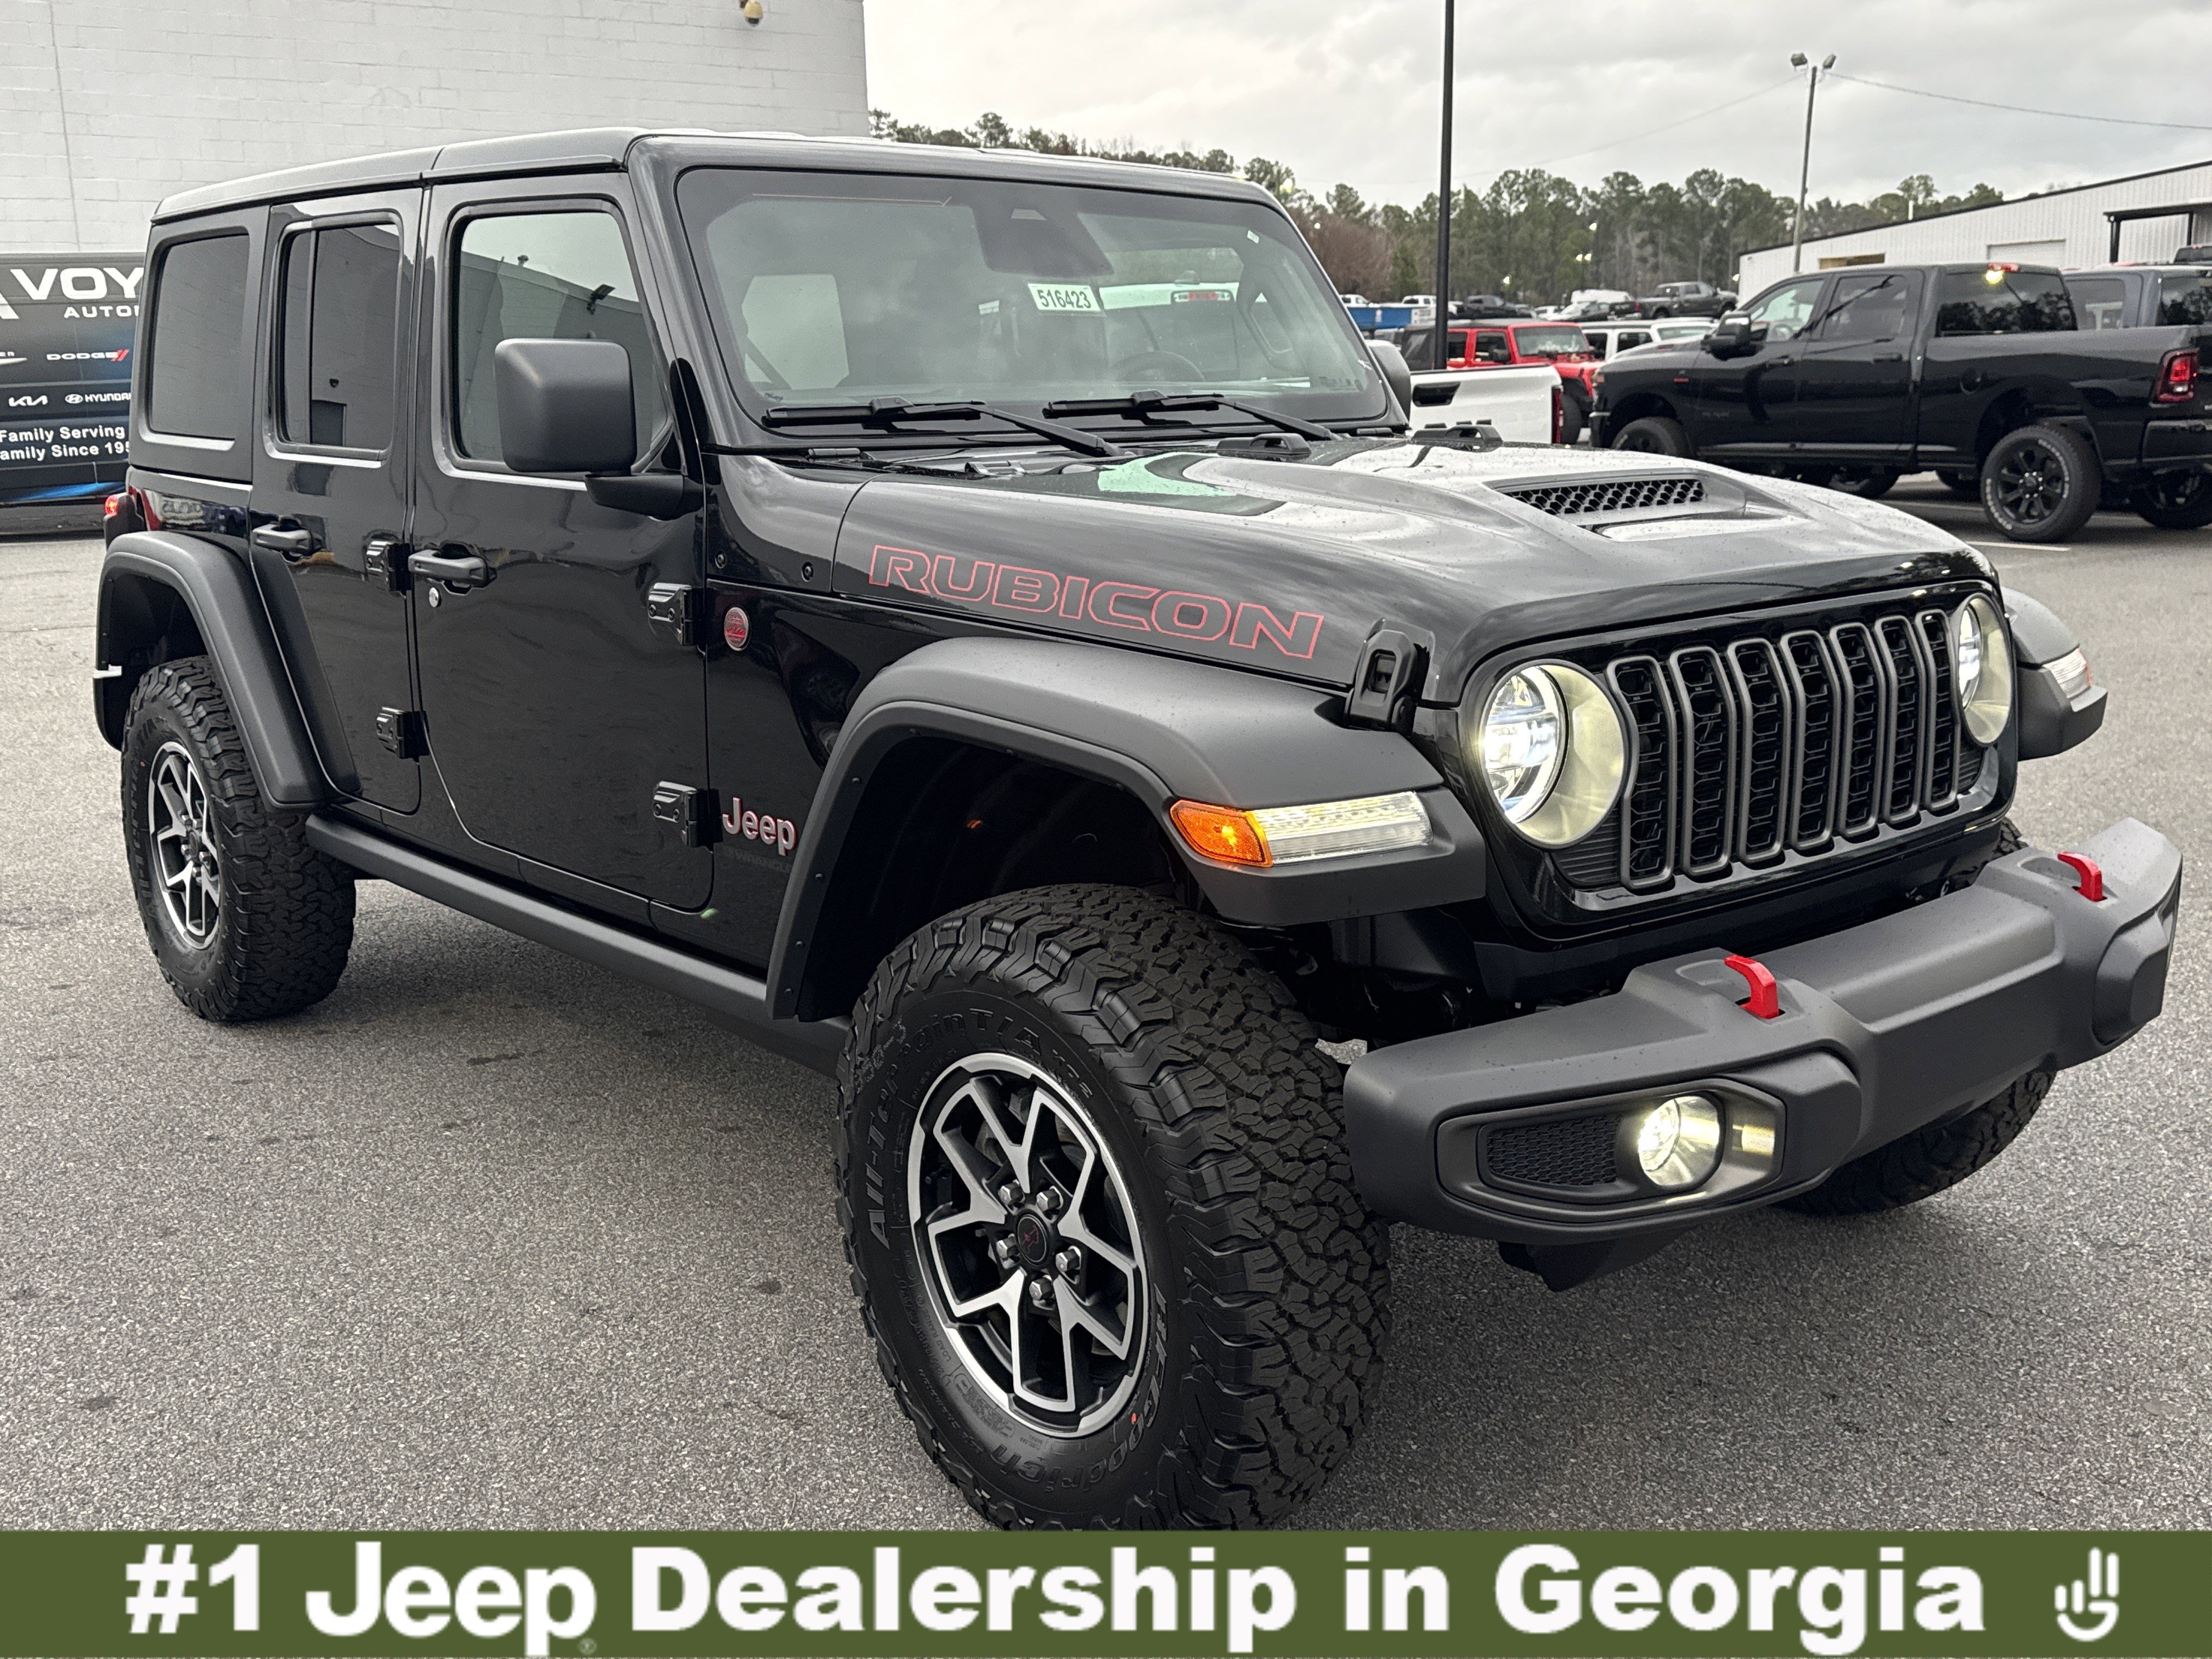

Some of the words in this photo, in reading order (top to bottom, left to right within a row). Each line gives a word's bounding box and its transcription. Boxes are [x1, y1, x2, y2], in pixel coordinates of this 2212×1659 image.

[10, 267, 144, 300] VOY
[1037, 289, 1091, 308] 516423
[47, 352, 119, 360] DODGE
[8, 395, 48, 407] KIA
[0, 428, 54, 443] Family
[59, 425, 125, 439] Serving
[51, 444, 99, 458] Since
[869, 545, 1323, 659] RUBICON
[722, 797, 797, 856] Jeep
[990, 1282, 1167, 1492] BFGoodrich
